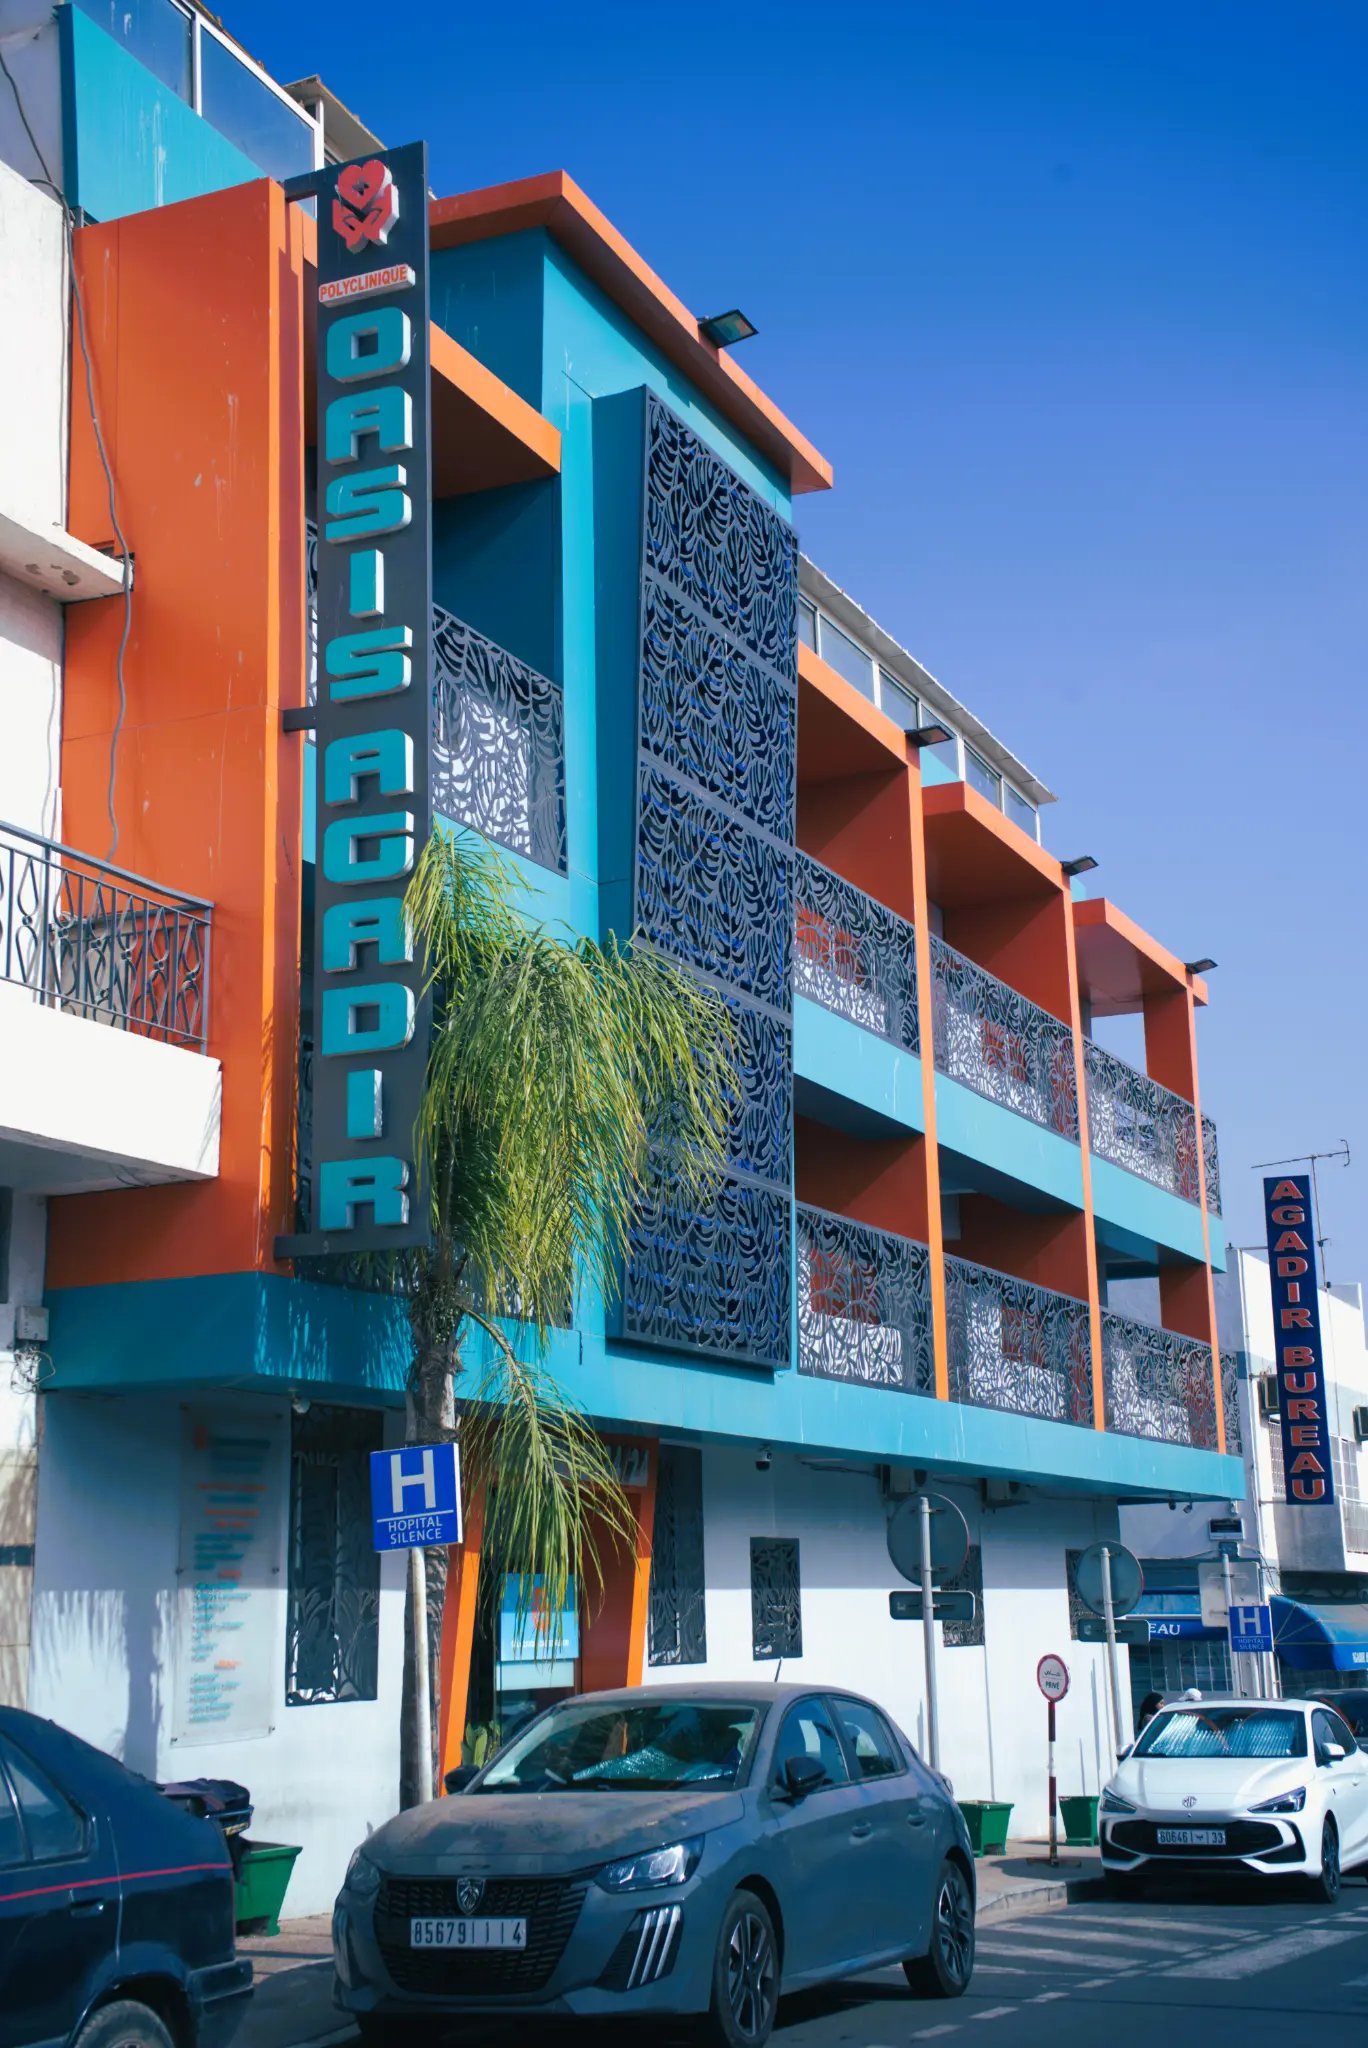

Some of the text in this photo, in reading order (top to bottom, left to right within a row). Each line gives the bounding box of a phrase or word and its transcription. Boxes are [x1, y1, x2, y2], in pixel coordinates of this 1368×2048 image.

[319, 266, 408, 301] POLYCLINIQUE
[325, 306, 414, 702] OASIS
[320, 728, 415, 1230] AGADIR
[1271, 1180, 1326, 1500] AGADIR BUREAU
[391, 1449, 436, 1514] H
[388, 1515, 443, 1532] HOPITAL
[390, 1528, 442, 1545] SILENCE
[1238, 1607, 1262, 1635] H
